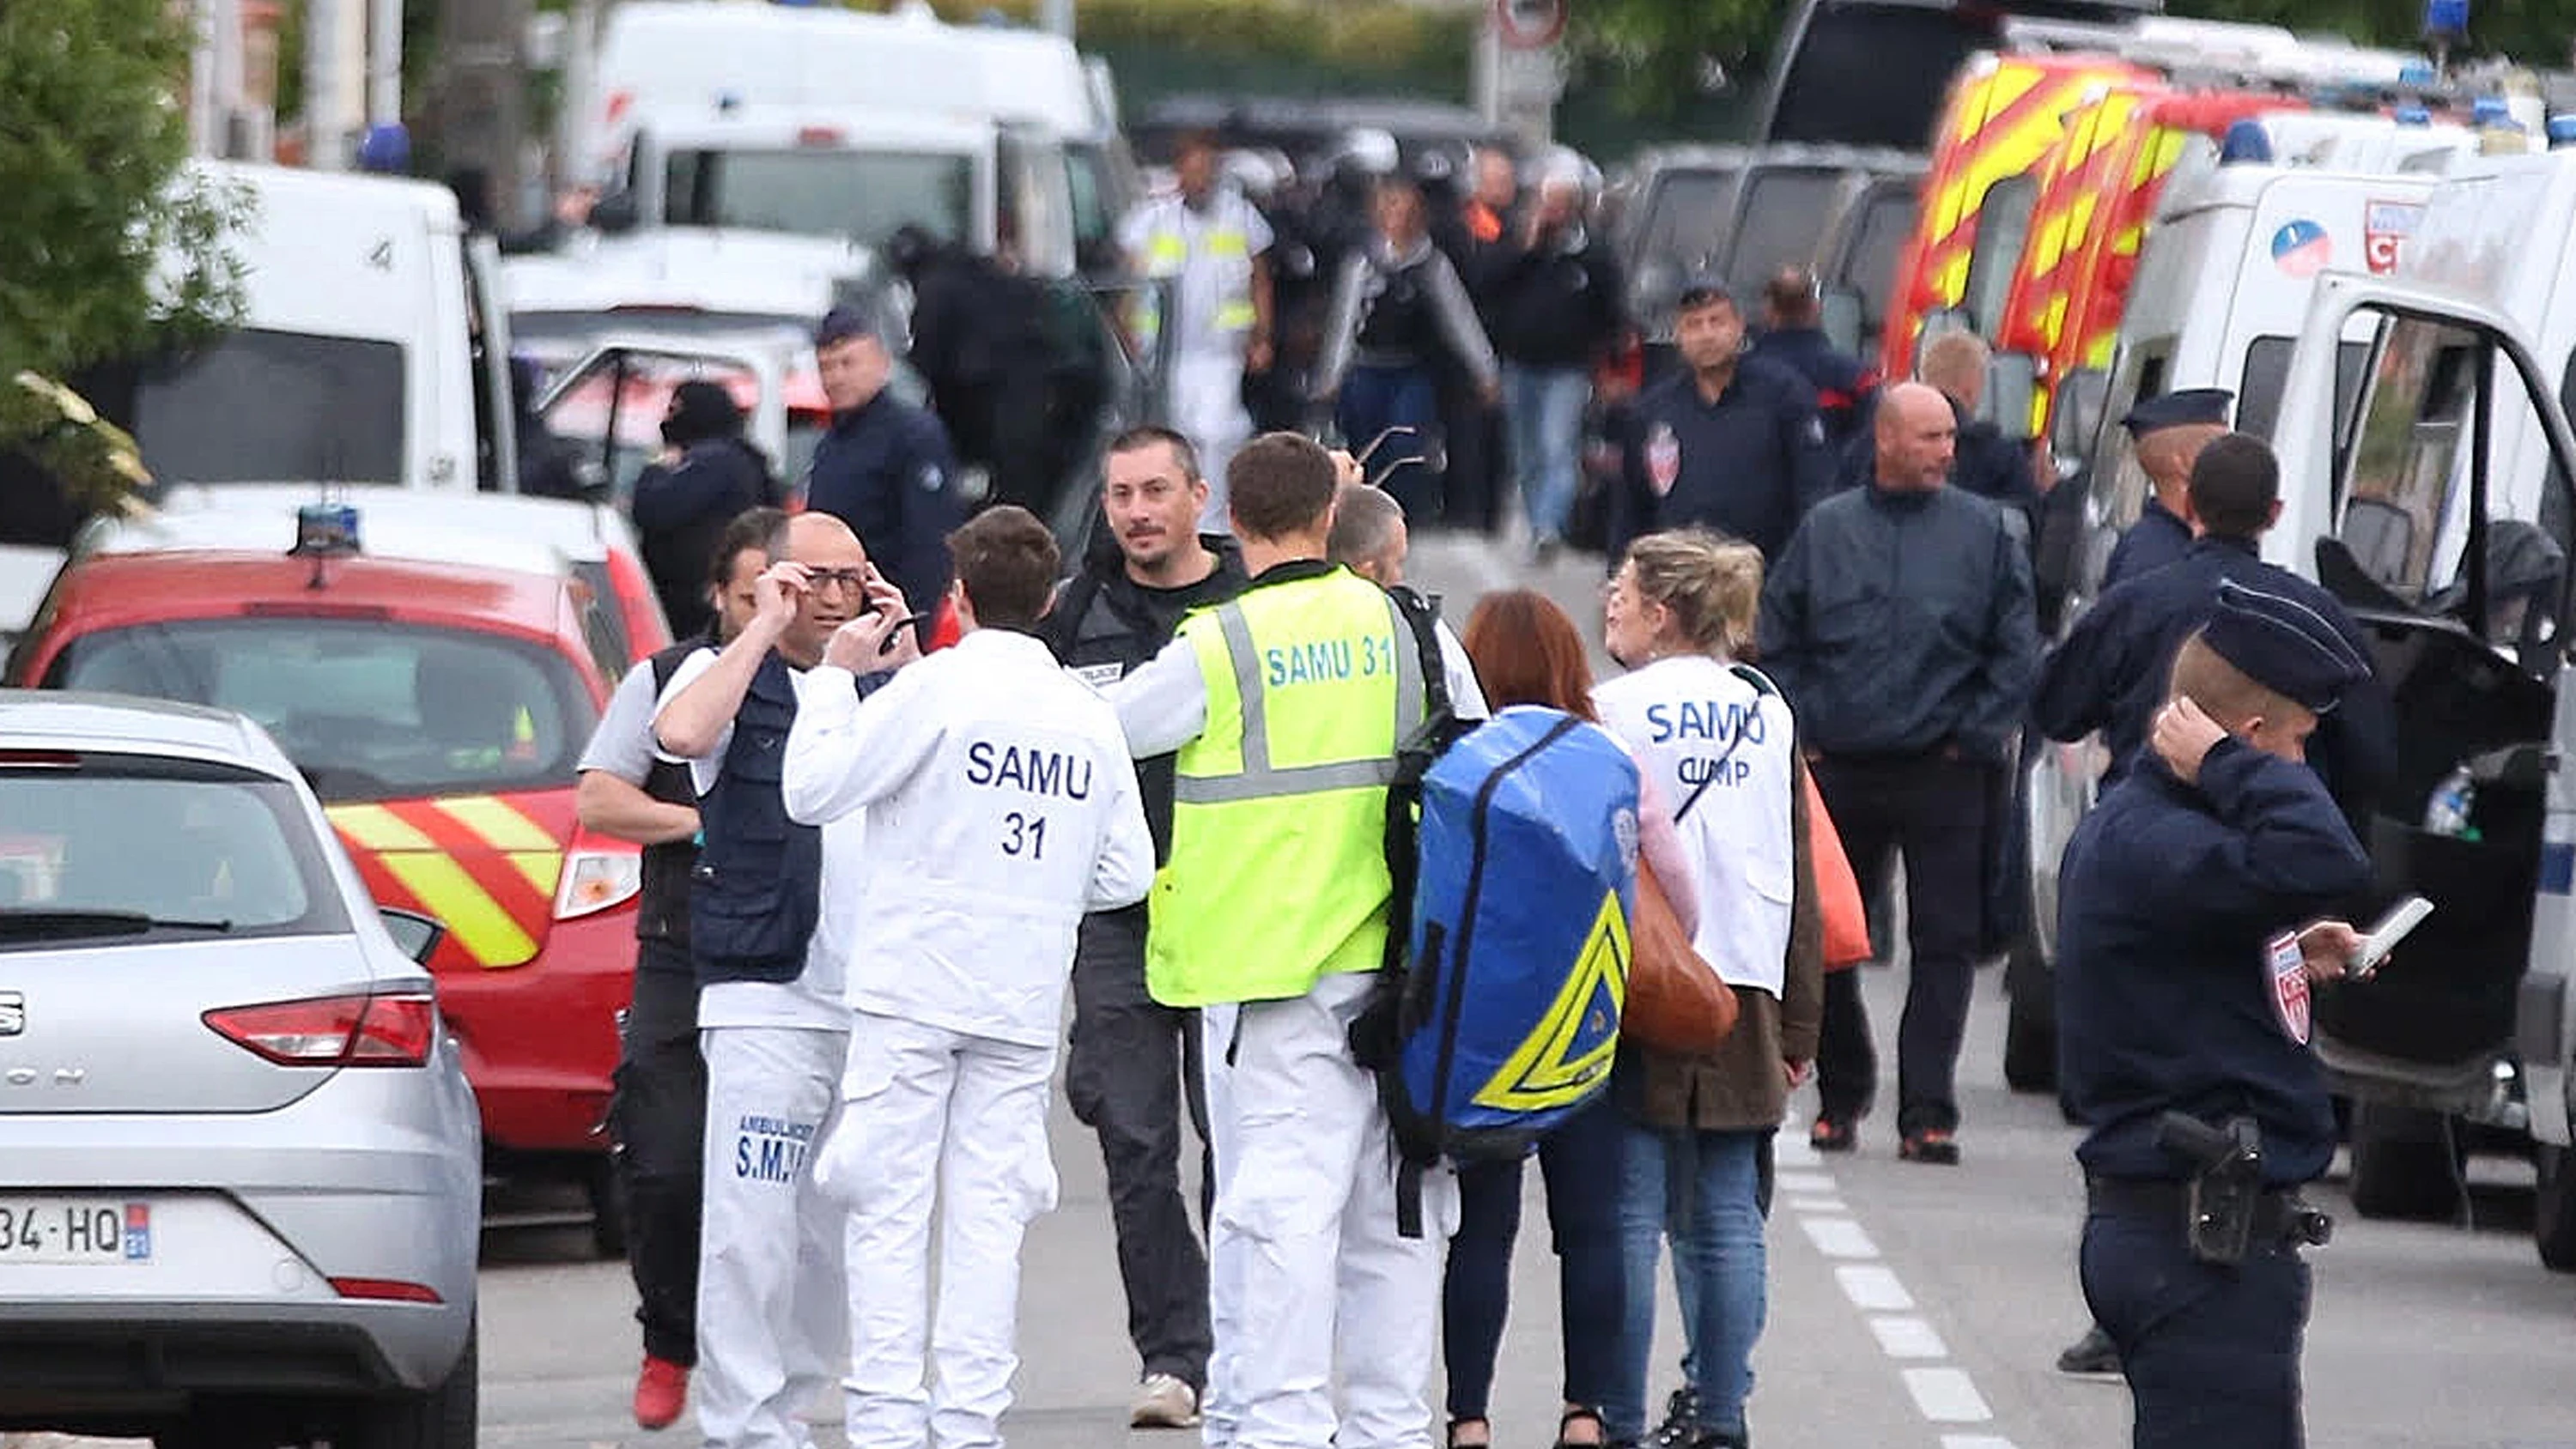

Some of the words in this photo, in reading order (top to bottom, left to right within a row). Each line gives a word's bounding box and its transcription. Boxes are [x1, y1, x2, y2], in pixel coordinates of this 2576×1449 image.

[1267, 639, 1351, 686] SAMU
[1363, 635, 1391, 676] 31
[1647, 701, 1765, 744] SAMU
[967, 742, 1091, 800] SAMU
[1002, 812, 1045, 859] 31
